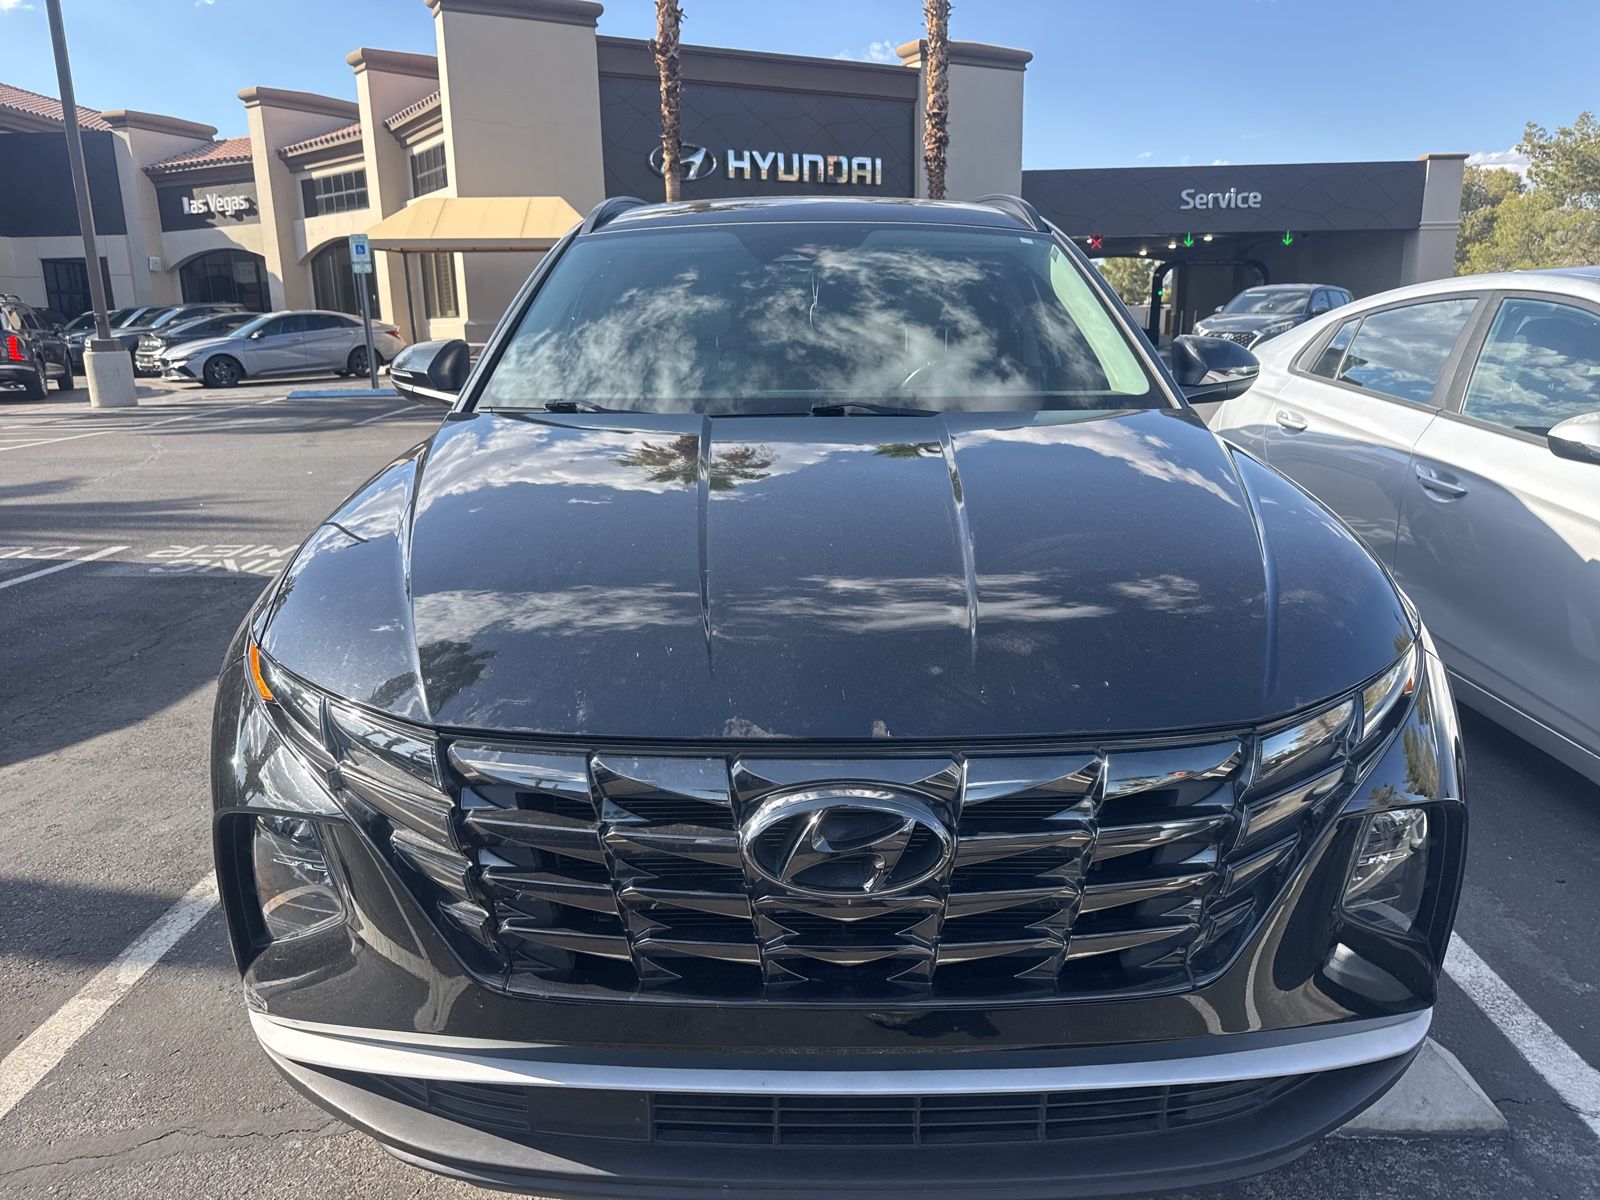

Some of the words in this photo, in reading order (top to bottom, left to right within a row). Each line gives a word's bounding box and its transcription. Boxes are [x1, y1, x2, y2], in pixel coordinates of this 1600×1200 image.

[727, 149, 882, 185] HYUNDAI
[182, 196, 207, 214] Las
[206, 193, 249, 215] Vegas
[1180, 187, 1262, 210] Service
